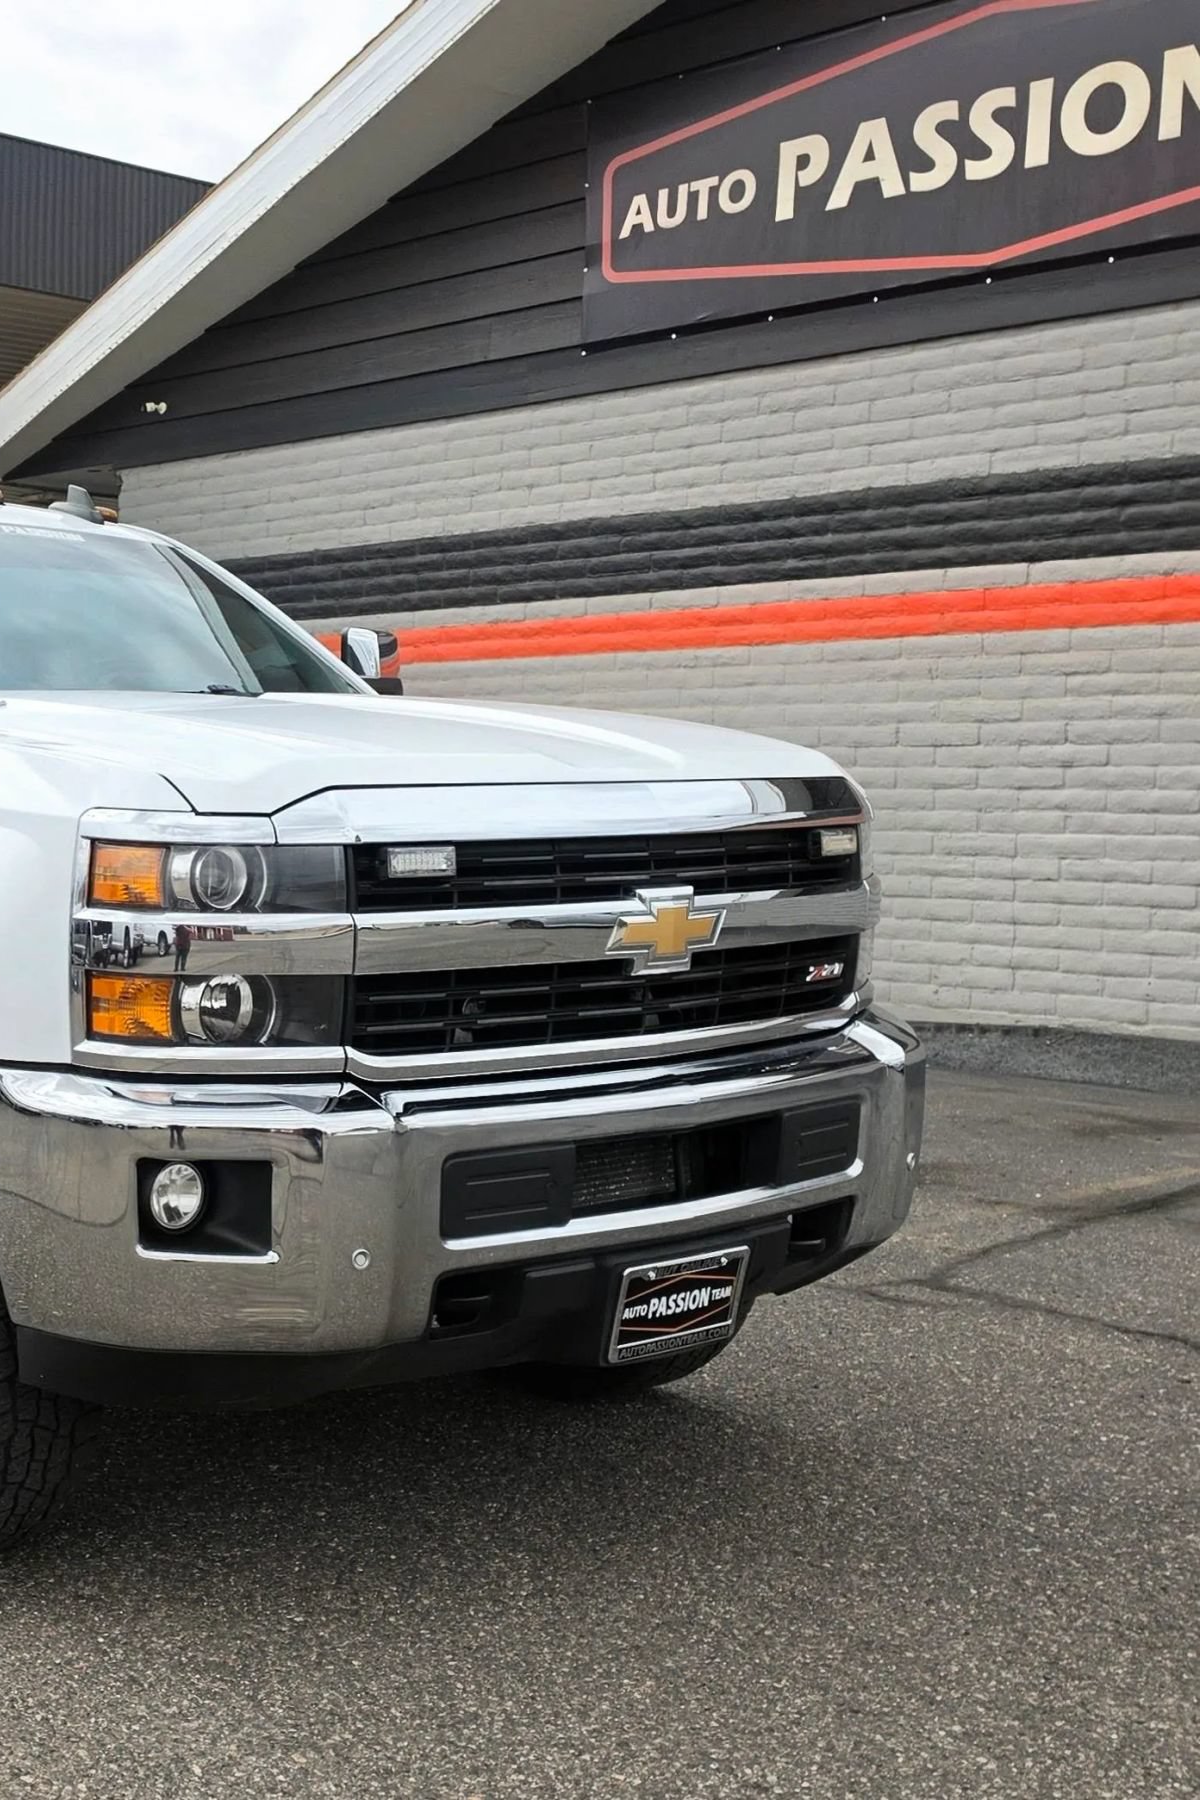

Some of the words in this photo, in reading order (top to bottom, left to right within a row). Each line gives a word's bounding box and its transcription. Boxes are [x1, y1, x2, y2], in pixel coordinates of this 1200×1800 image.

[619, 168, 757, 240] AUTO
[622, 1304, 648, 1320] AUTO
[647, 1286, 711, 1319] PASSION
[711, 1285, 733, 1300] TEAM
[619, 1326, 729, 1359] AUTOPASSIONTEAM.COM
